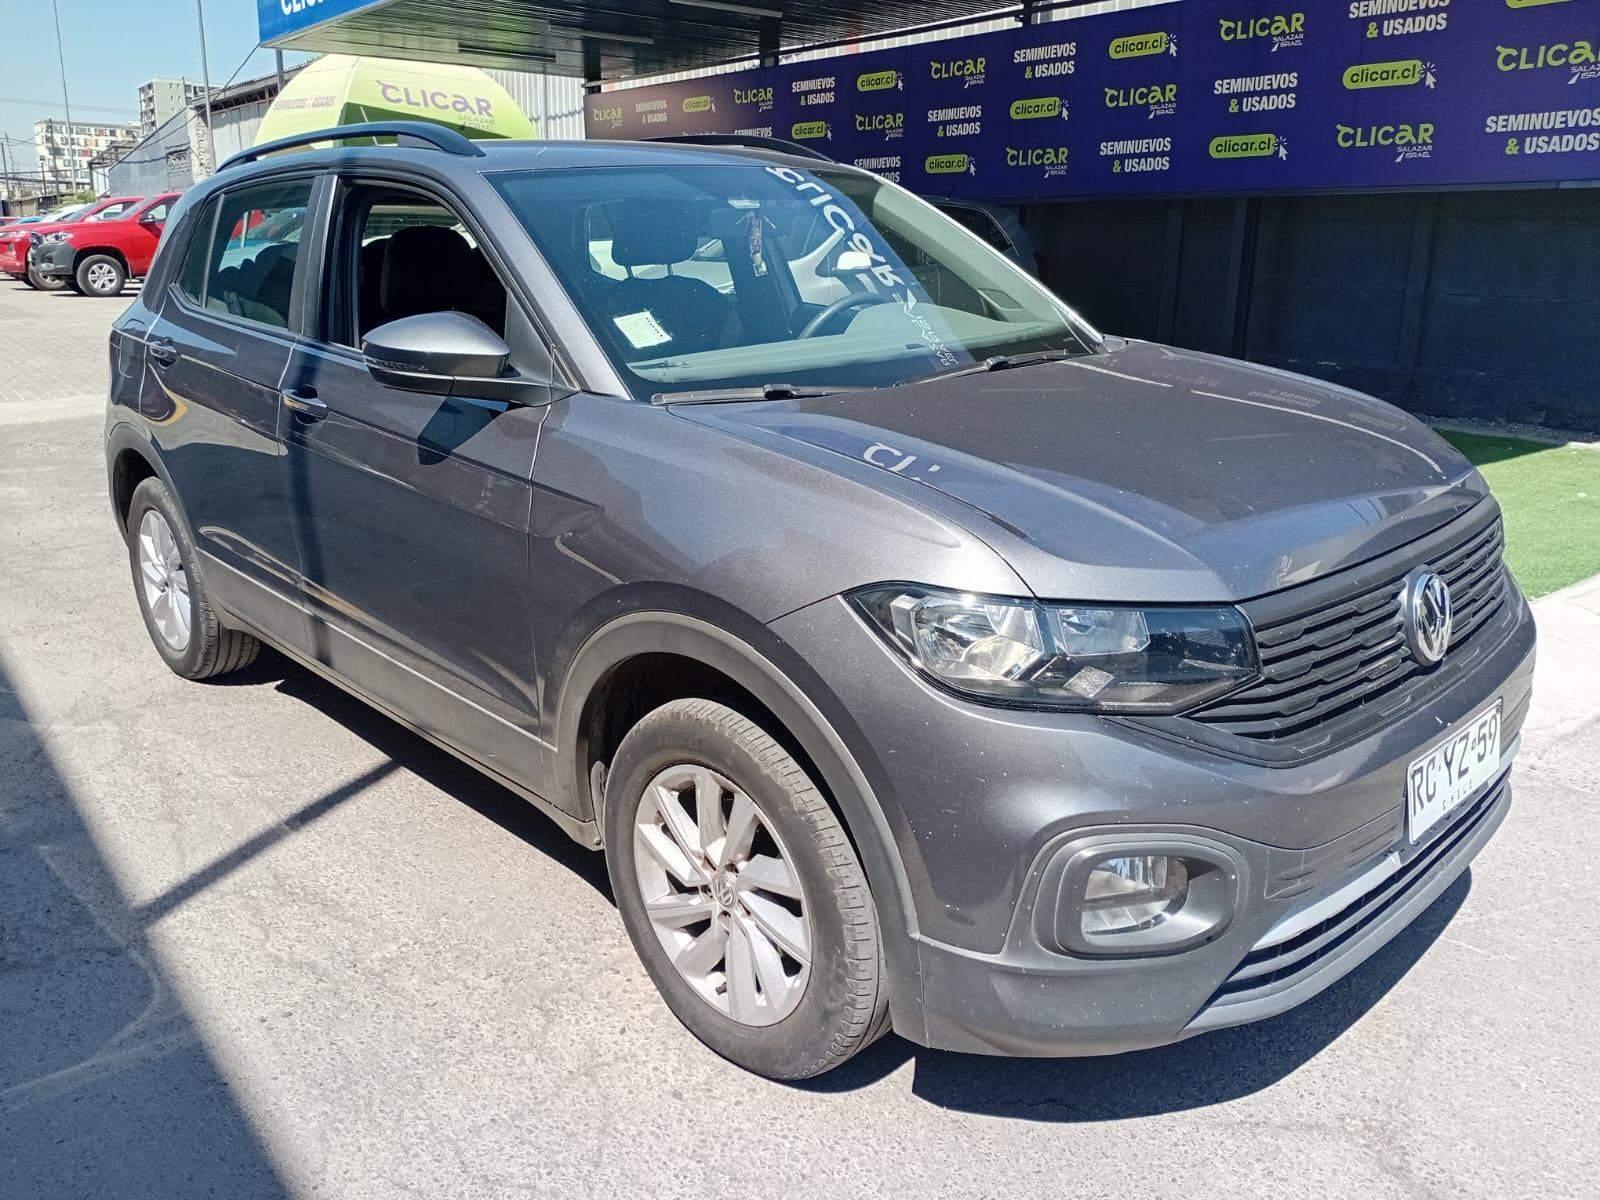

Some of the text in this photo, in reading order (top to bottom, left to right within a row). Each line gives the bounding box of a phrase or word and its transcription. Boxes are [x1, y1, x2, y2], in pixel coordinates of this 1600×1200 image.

[1366, 13, 1448, 38] & USADOS
[1013, 42, 1077, 63] SEMINUEVOS
[1114, 35, 1163, 54] clicar.cl
[1496, 41, 1600, 71] CLICA
[1024, 60, 1075, 79] & USADOS
[1350, 63, 1417, 84] clicar.cl
[792, 77, 835, 93] SEMINUEVOS
[860, 75, 894, 88] clicar.cl
[1213, 72, 1298, 95] SEMINUEVOS
[800, 92, 835, 106] & USADOS
[1014, 100, 1057, 115] clicar.cl
[1228, 93, 1296, 113] & USADOS
[928, 105, 982, 122] SEMINUEVOS
[1485, 108, 1600, 133] SEMINUEVOS
[794, 125, 823, 136] clicar.cl
[937, 122, 981, 137] & USADOS
[1100, 137, 1172, 156] SEMINUEVOS
[1215, 137, 1271, 154] clicar.cl
[1505, 133, 1600, 155] & USADOS
[929, 156, 965, 170] clicar.cl
[1112, 157, 1170, 173] & USADOS
